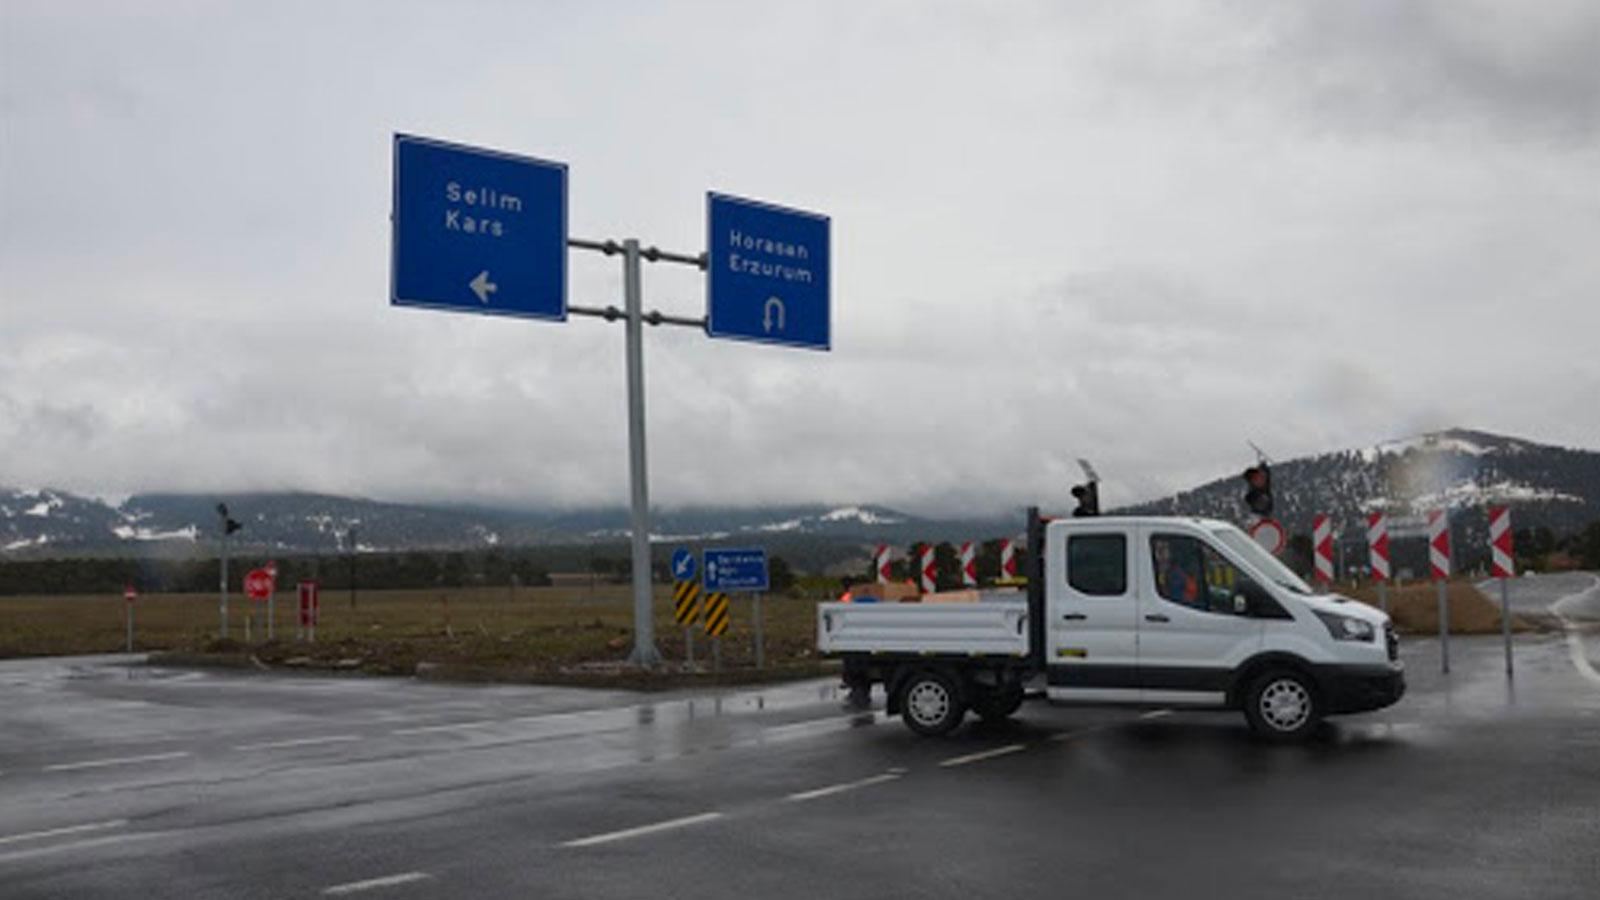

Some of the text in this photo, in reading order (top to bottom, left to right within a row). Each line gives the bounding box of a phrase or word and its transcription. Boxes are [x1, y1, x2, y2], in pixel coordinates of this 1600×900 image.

[445, 182, 523, 212] Selim
[445, 210, 503, 237] Kars
[729, 229, 809, 259] Horasan
[729, 254, 812, 283] Erzurum
